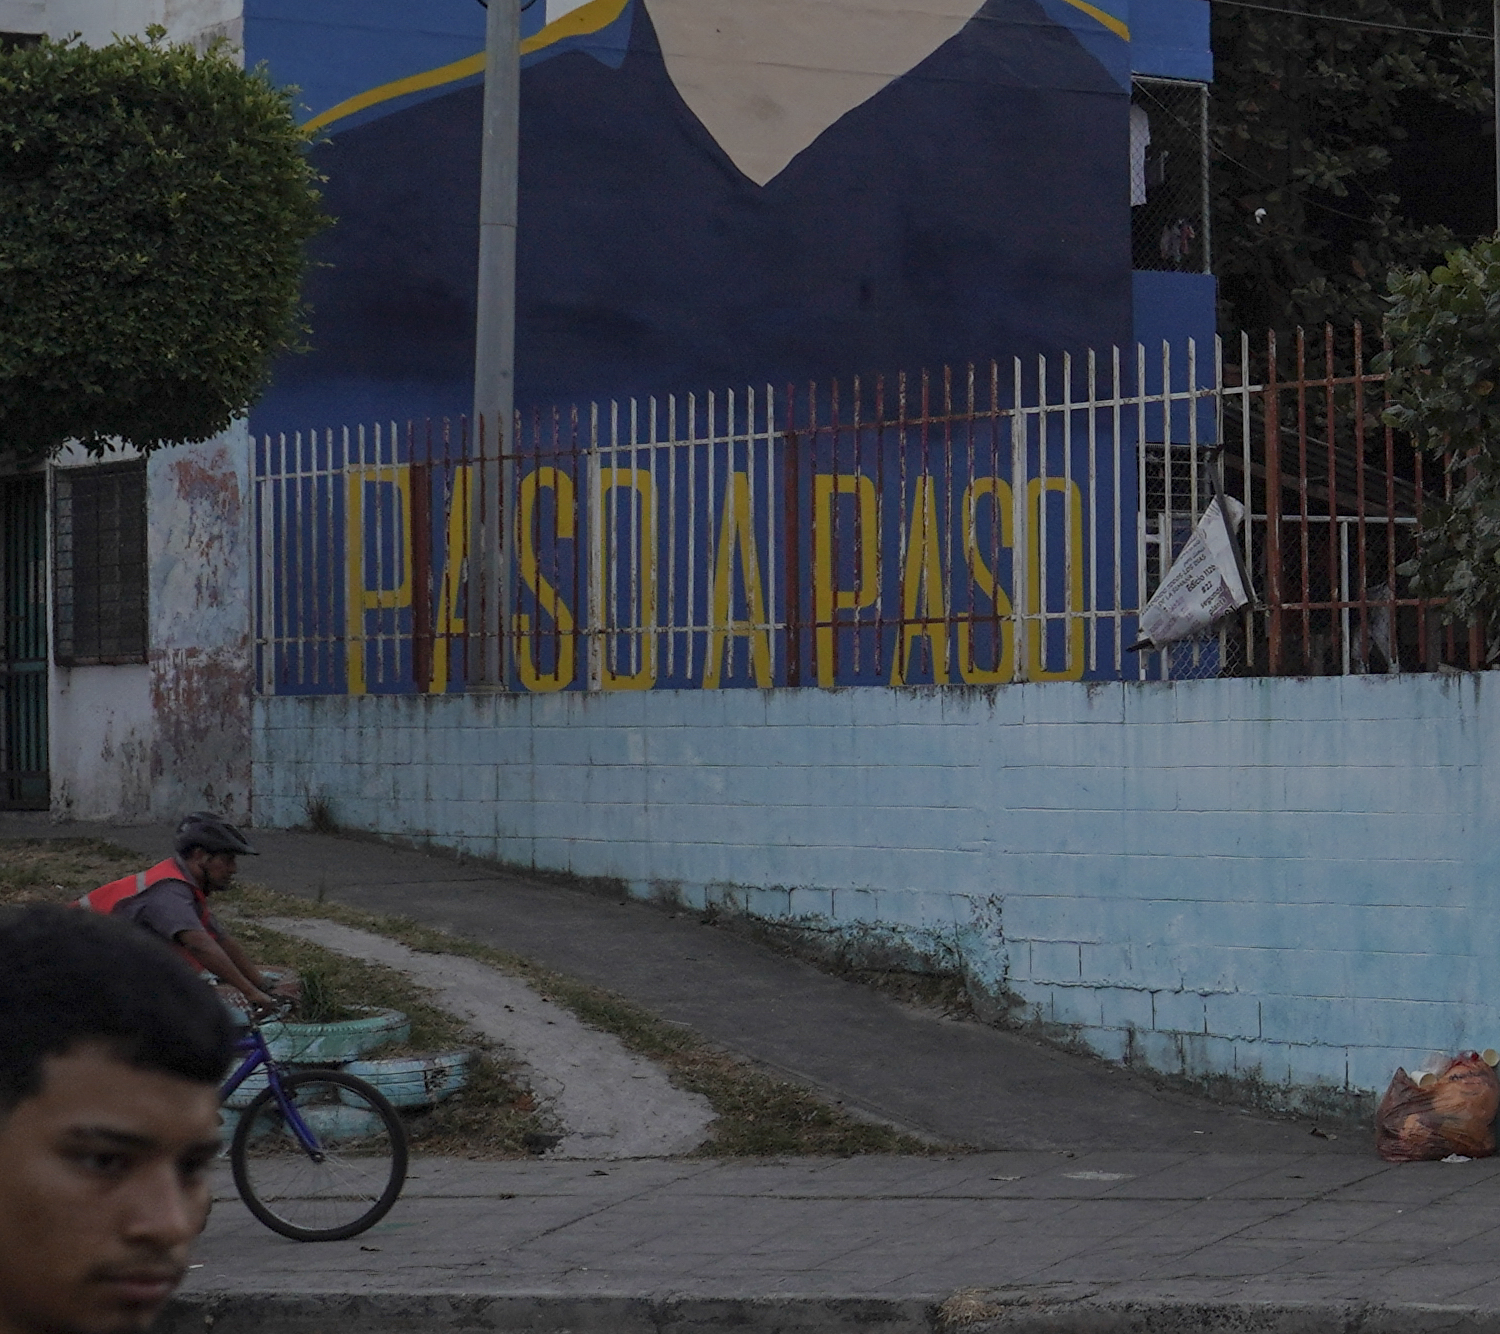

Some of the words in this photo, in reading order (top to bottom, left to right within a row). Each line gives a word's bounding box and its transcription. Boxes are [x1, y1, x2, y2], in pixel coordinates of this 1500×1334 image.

[346, 464, 657, 695] PASO
[703, 470, 773, 690] A
[813, 472, 1085, 689] PASO
